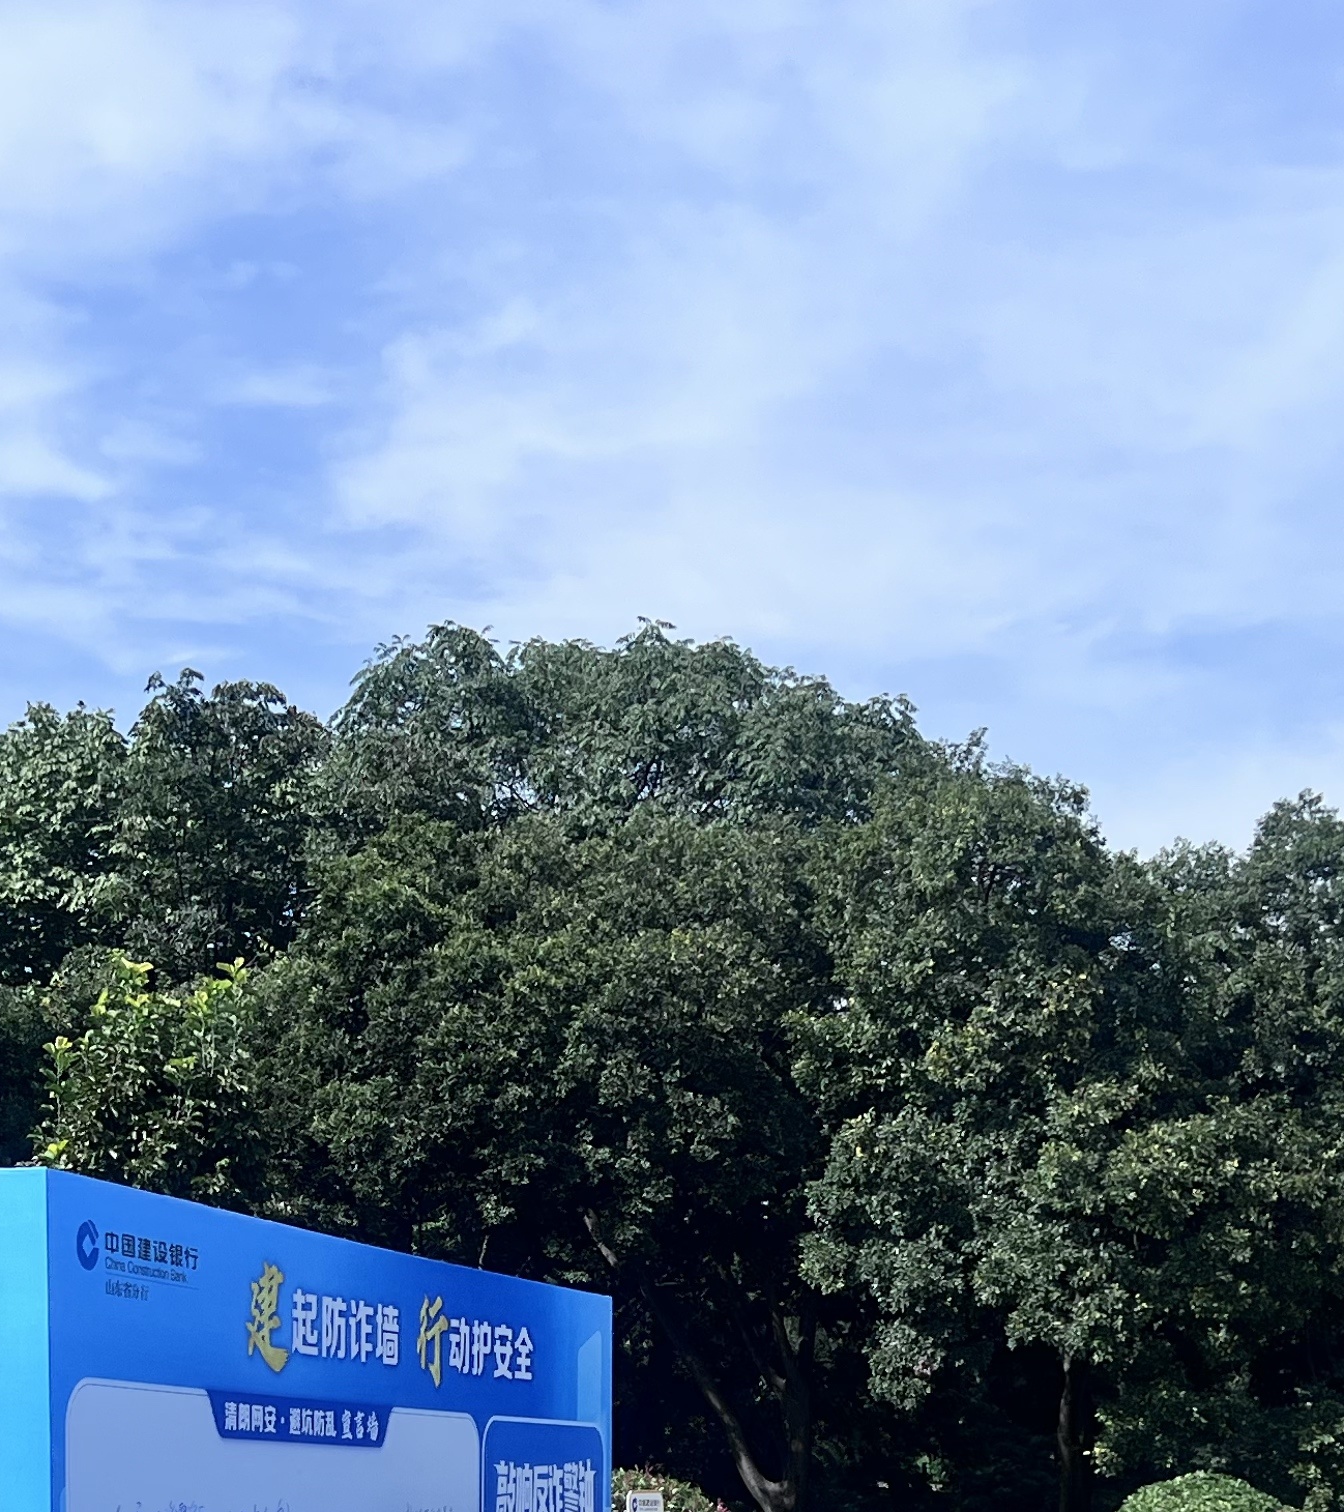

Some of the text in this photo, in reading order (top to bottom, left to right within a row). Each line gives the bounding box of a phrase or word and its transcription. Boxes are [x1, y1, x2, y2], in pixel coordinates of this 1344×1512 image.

[105, 1231, 199, 1270] 中国建设银行
[105, 1256, 188, 1283] China Construction Bank
[105, 1279, 150, 1301] 山东省分行
[246, 1262, 533, 1387] 建起防诈墙 行动护安全
